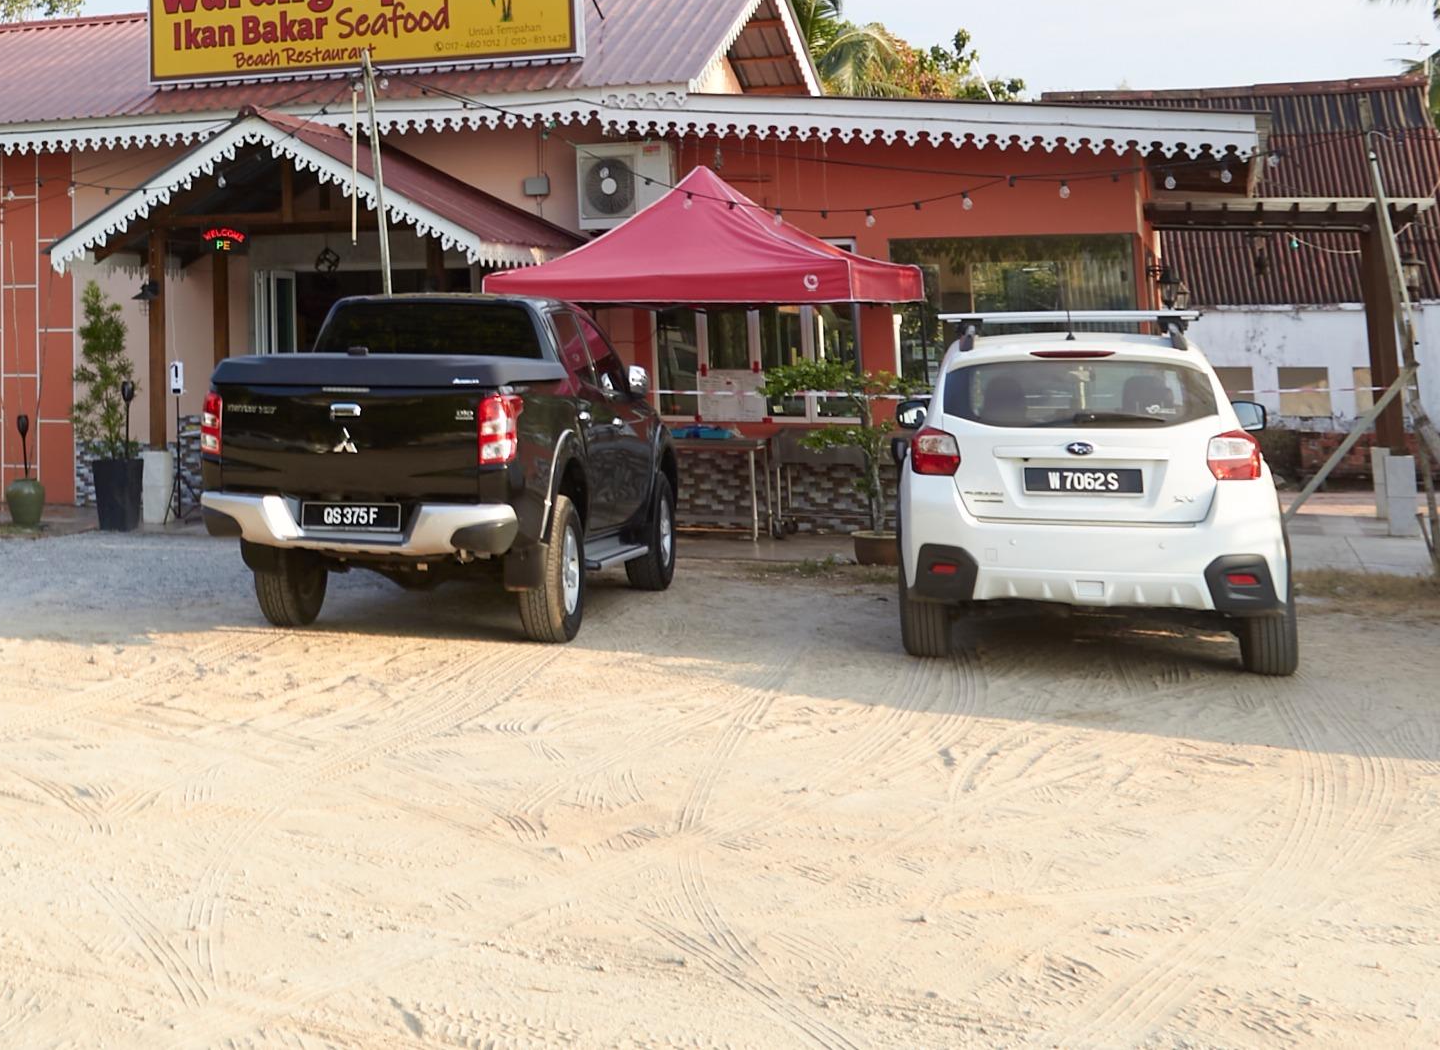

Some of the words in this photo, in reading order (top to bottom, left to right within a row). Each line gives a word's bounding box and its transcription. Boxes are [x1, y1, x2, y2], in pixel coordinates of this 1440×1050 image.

[173, 18, 236, 51] Ikan
[242, 10, 328, 46] Bakar
[468, 25, 494, 37] Untuk
[496, 23, 542, 35] Tempahan
[233, 49, 280, 69] Beach
[202, 229, 246, 243] WELCOME
[216, 240, 231, 250] PE
[1048, 471, 1060, 490] W
[1063, 472, 1106, 490] 7062
[1106, 472, 1119, 490] S
[323, 507, 341, 524] QS
[343, 507, 368, 525] 375
[368, 507, 379, 525] F
